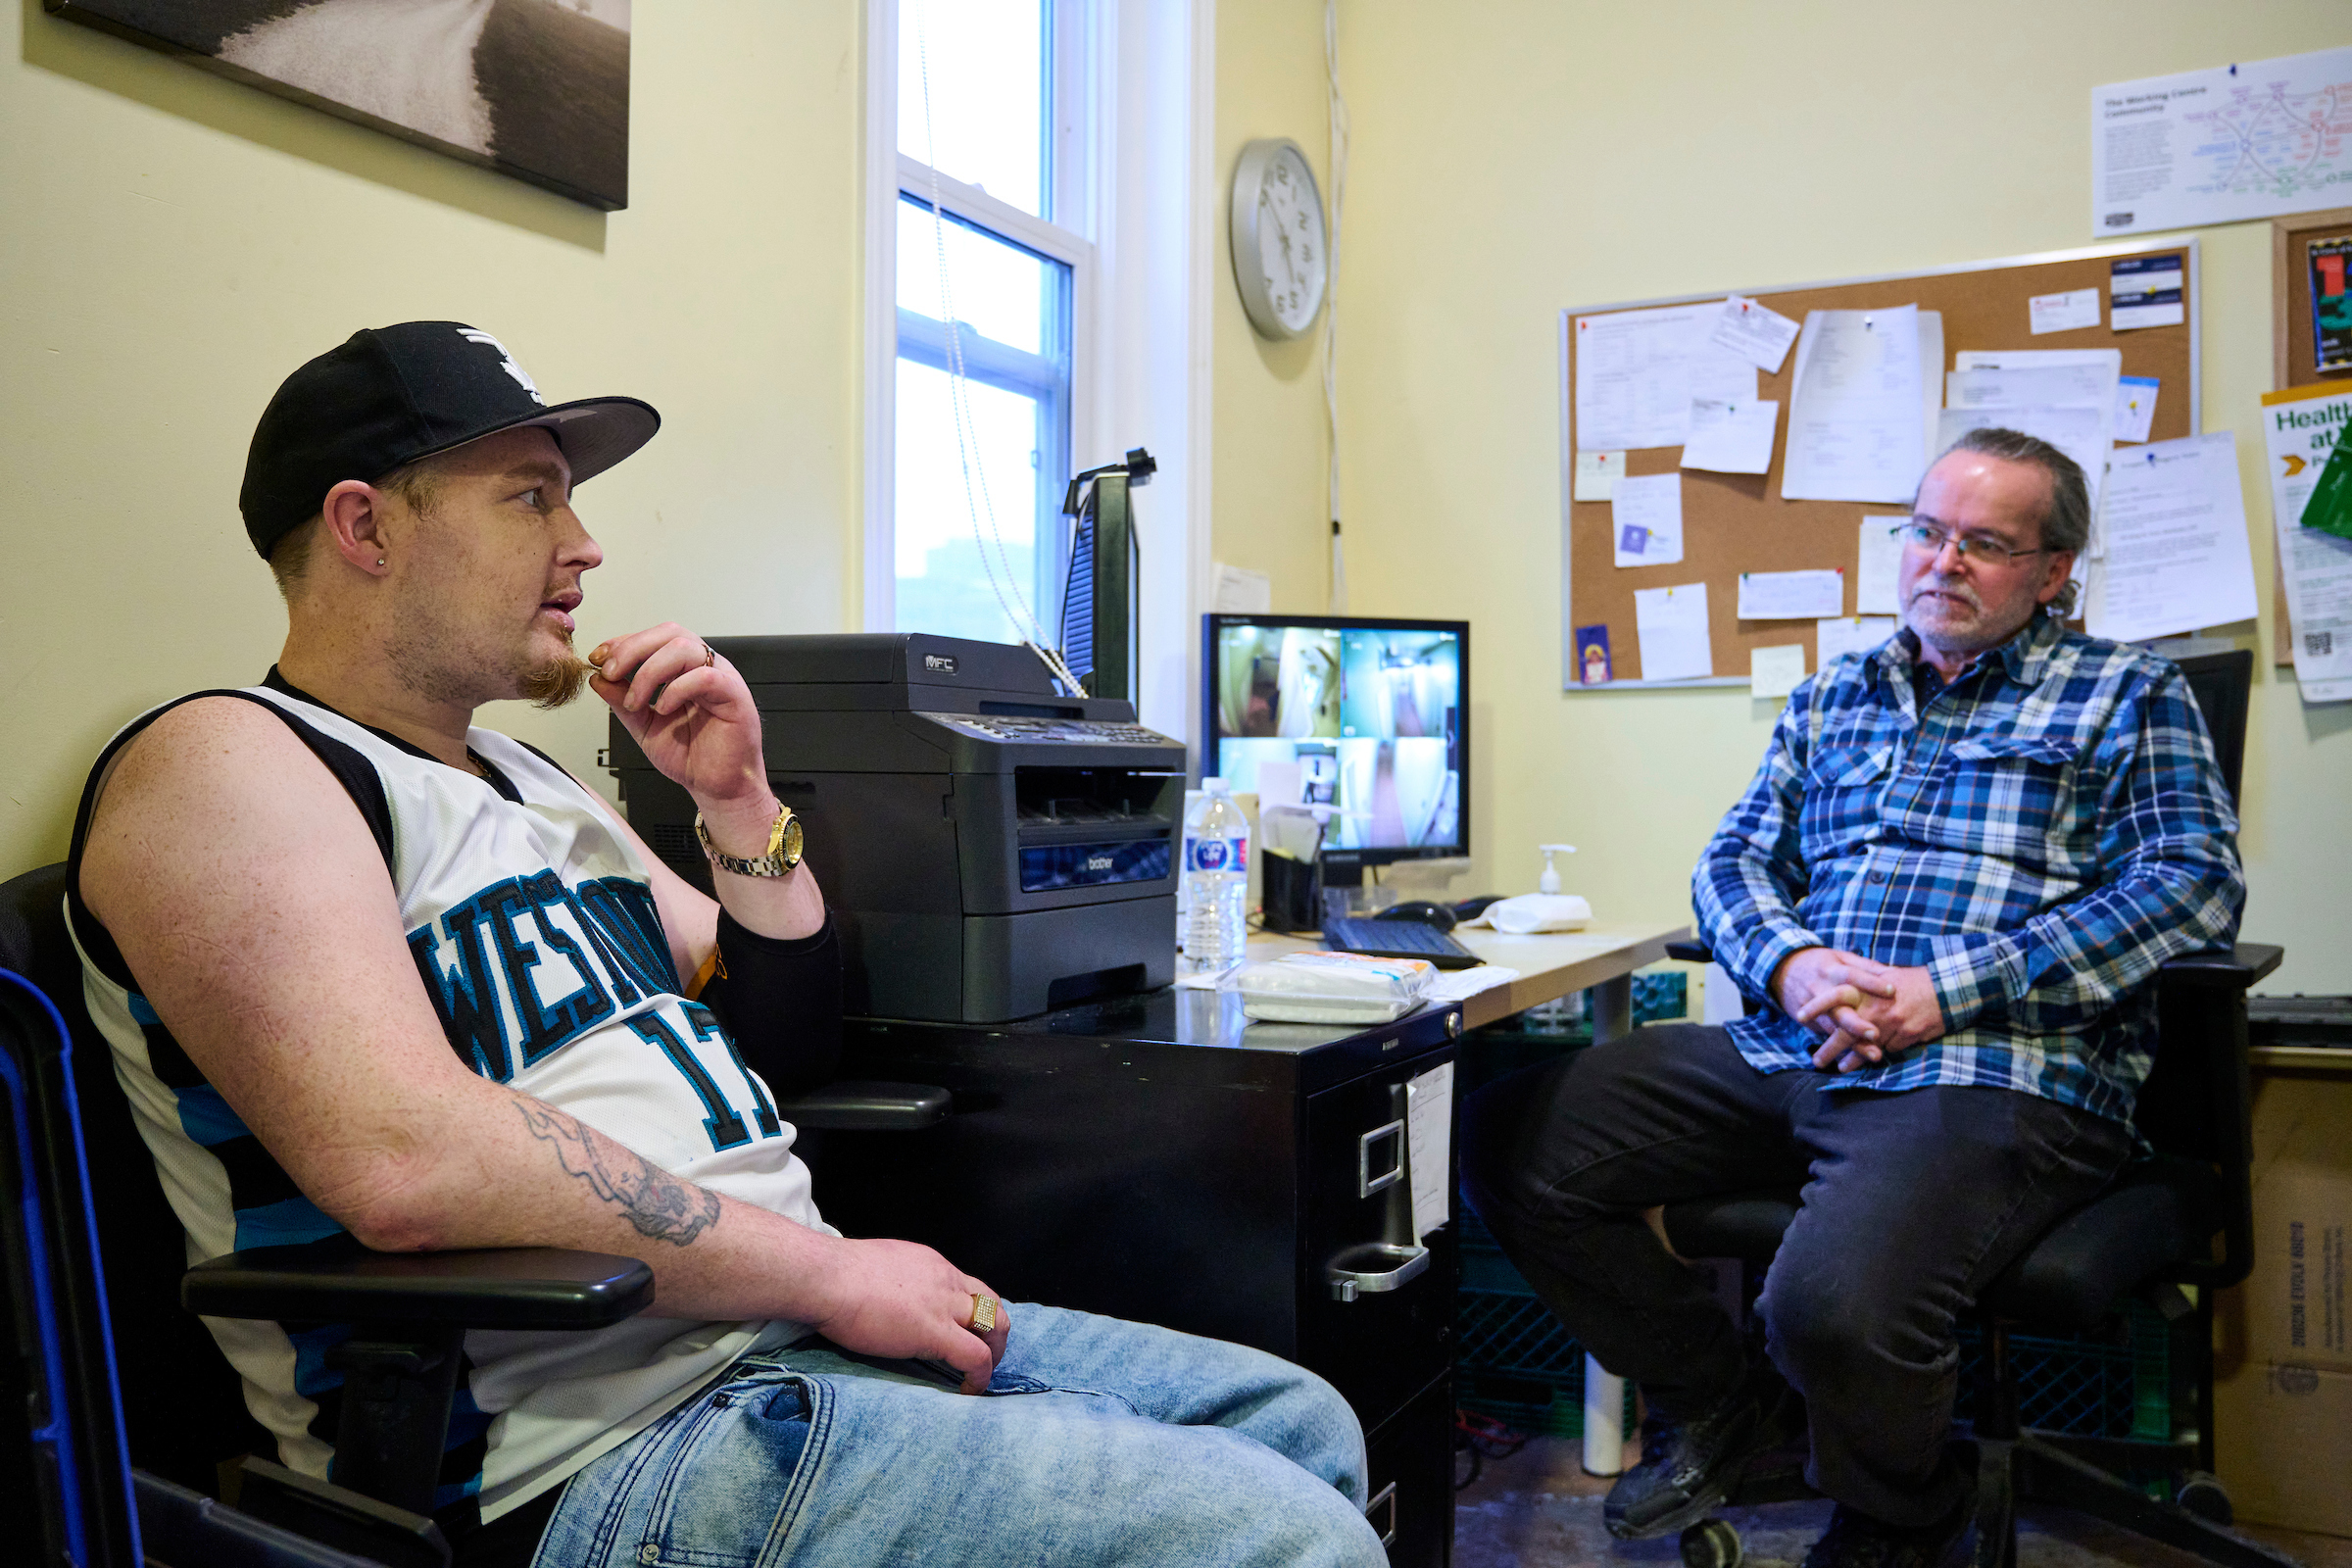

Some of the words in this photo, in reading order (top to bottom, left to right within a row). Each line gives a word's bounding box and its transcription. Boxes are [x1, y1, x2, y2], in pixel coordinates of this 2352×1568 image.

[2311, 428, 2332, 450] at
[925, 655, 954, 669] MFC
[1089, 858, 1113, 870] brother
[620, 1001, 782, 1152] 17
